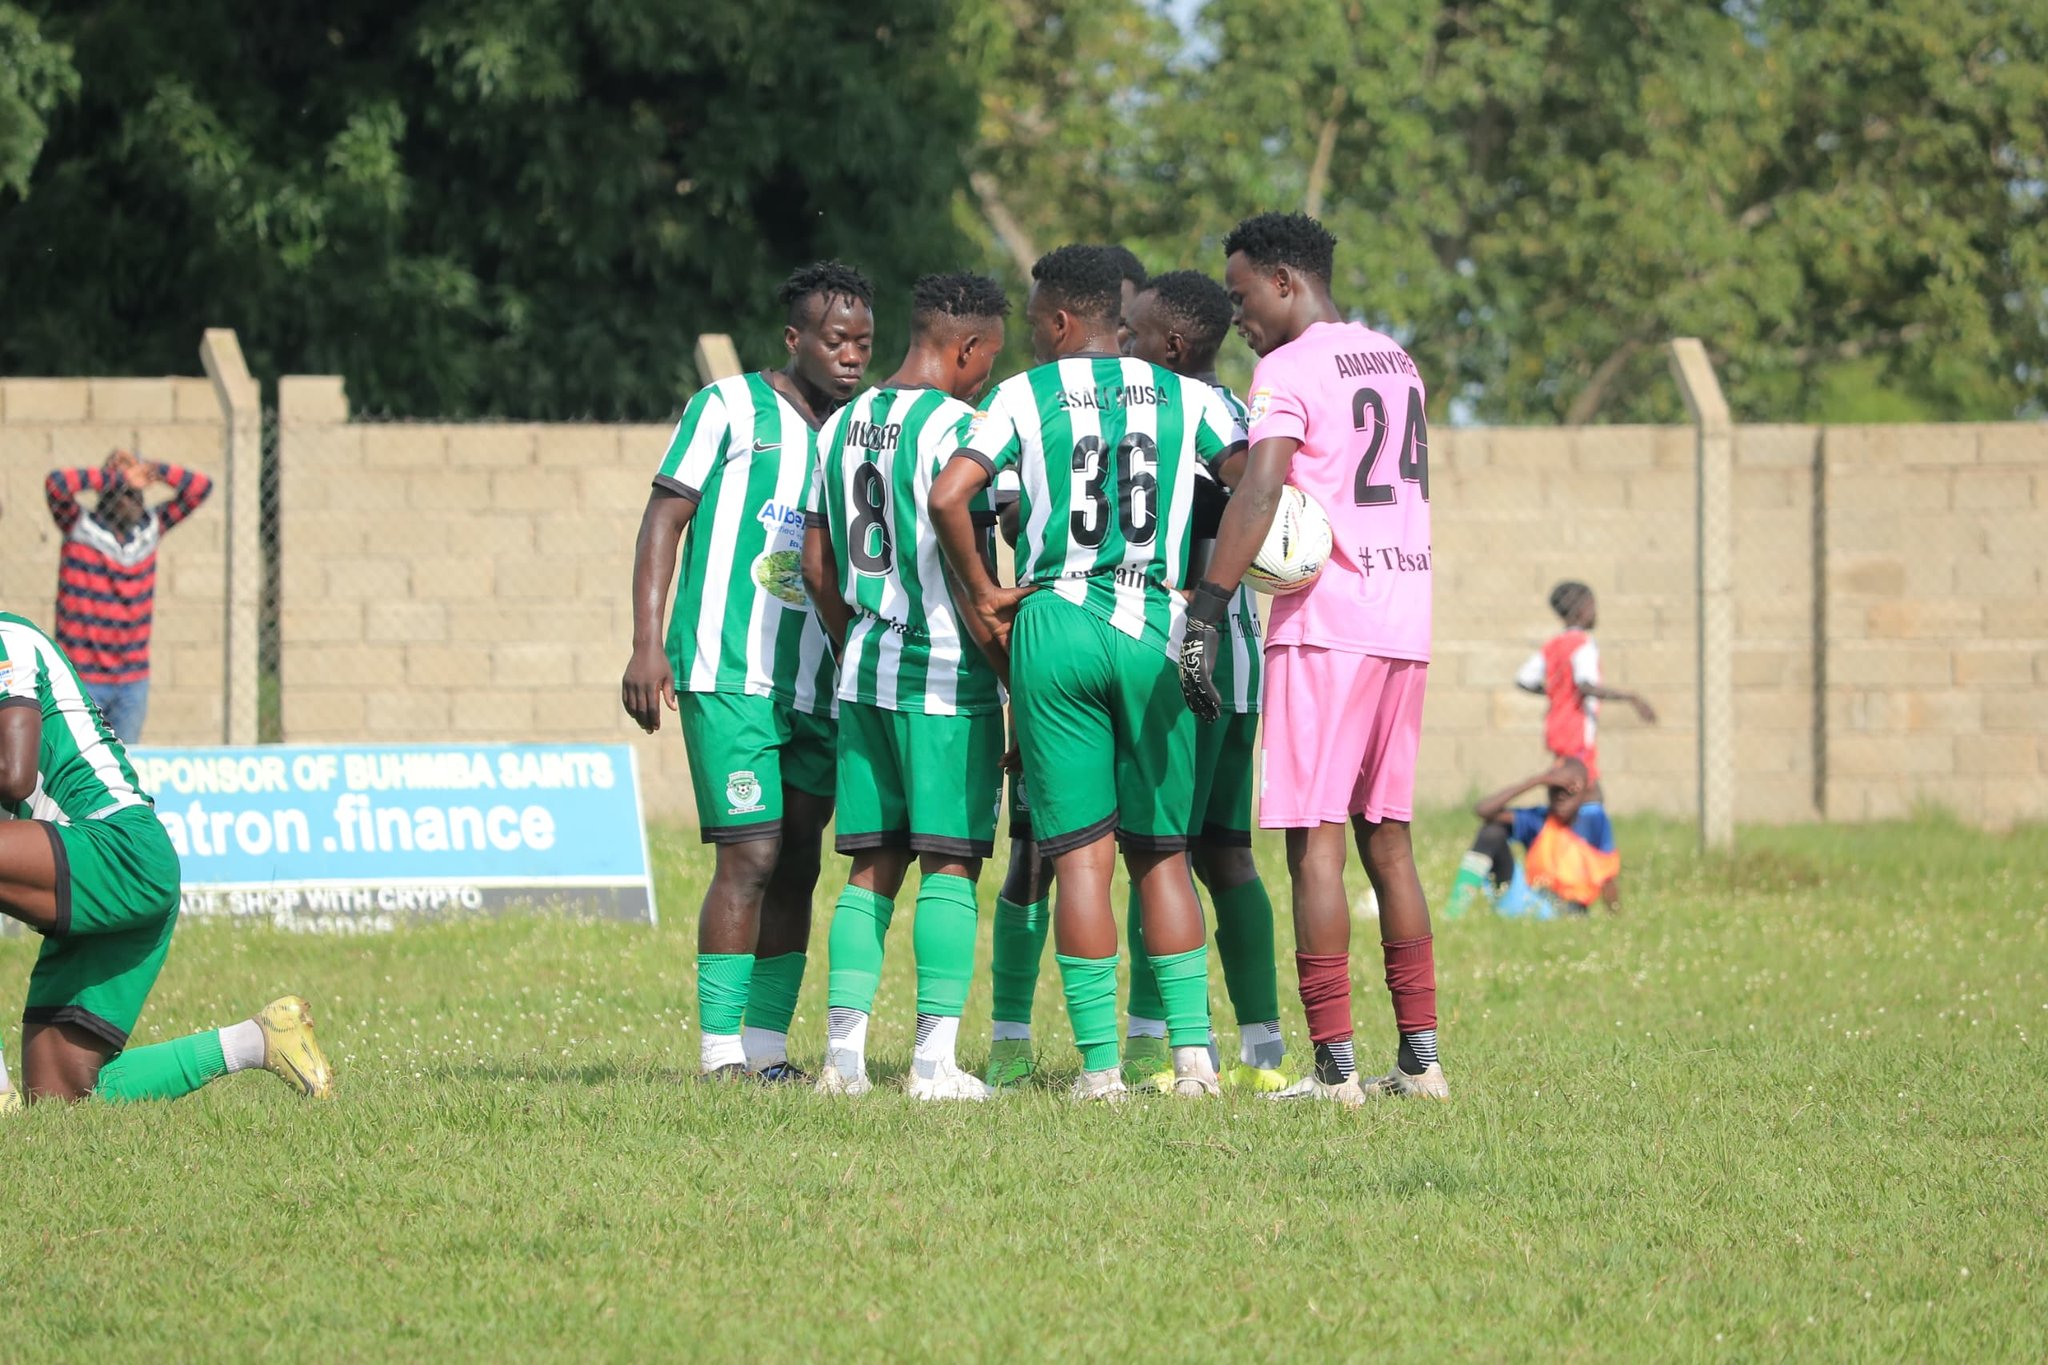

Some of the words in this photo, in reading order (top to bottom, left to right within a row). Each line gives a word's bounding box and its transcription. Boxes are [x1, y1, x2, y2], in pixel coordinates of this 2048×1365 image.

[1334, 351, 1417, 379] AMANYIRE
[1352, 386, 1430, 507] 24
[849, 460, 894, 577] 8
[1070, 432, 1161, 549] 36
[131, 756, 289, 794] SPONSOR
[292, 755, 338, 791] OF
[344, 753, 497, 790] BUHIMBA
[498, 752, 615, 789] SAINTS
[229, 889, 301, 915] SHOP
[304, 887, 373, 912] WITH
[377, 885, 484, 911] CRYPTO
